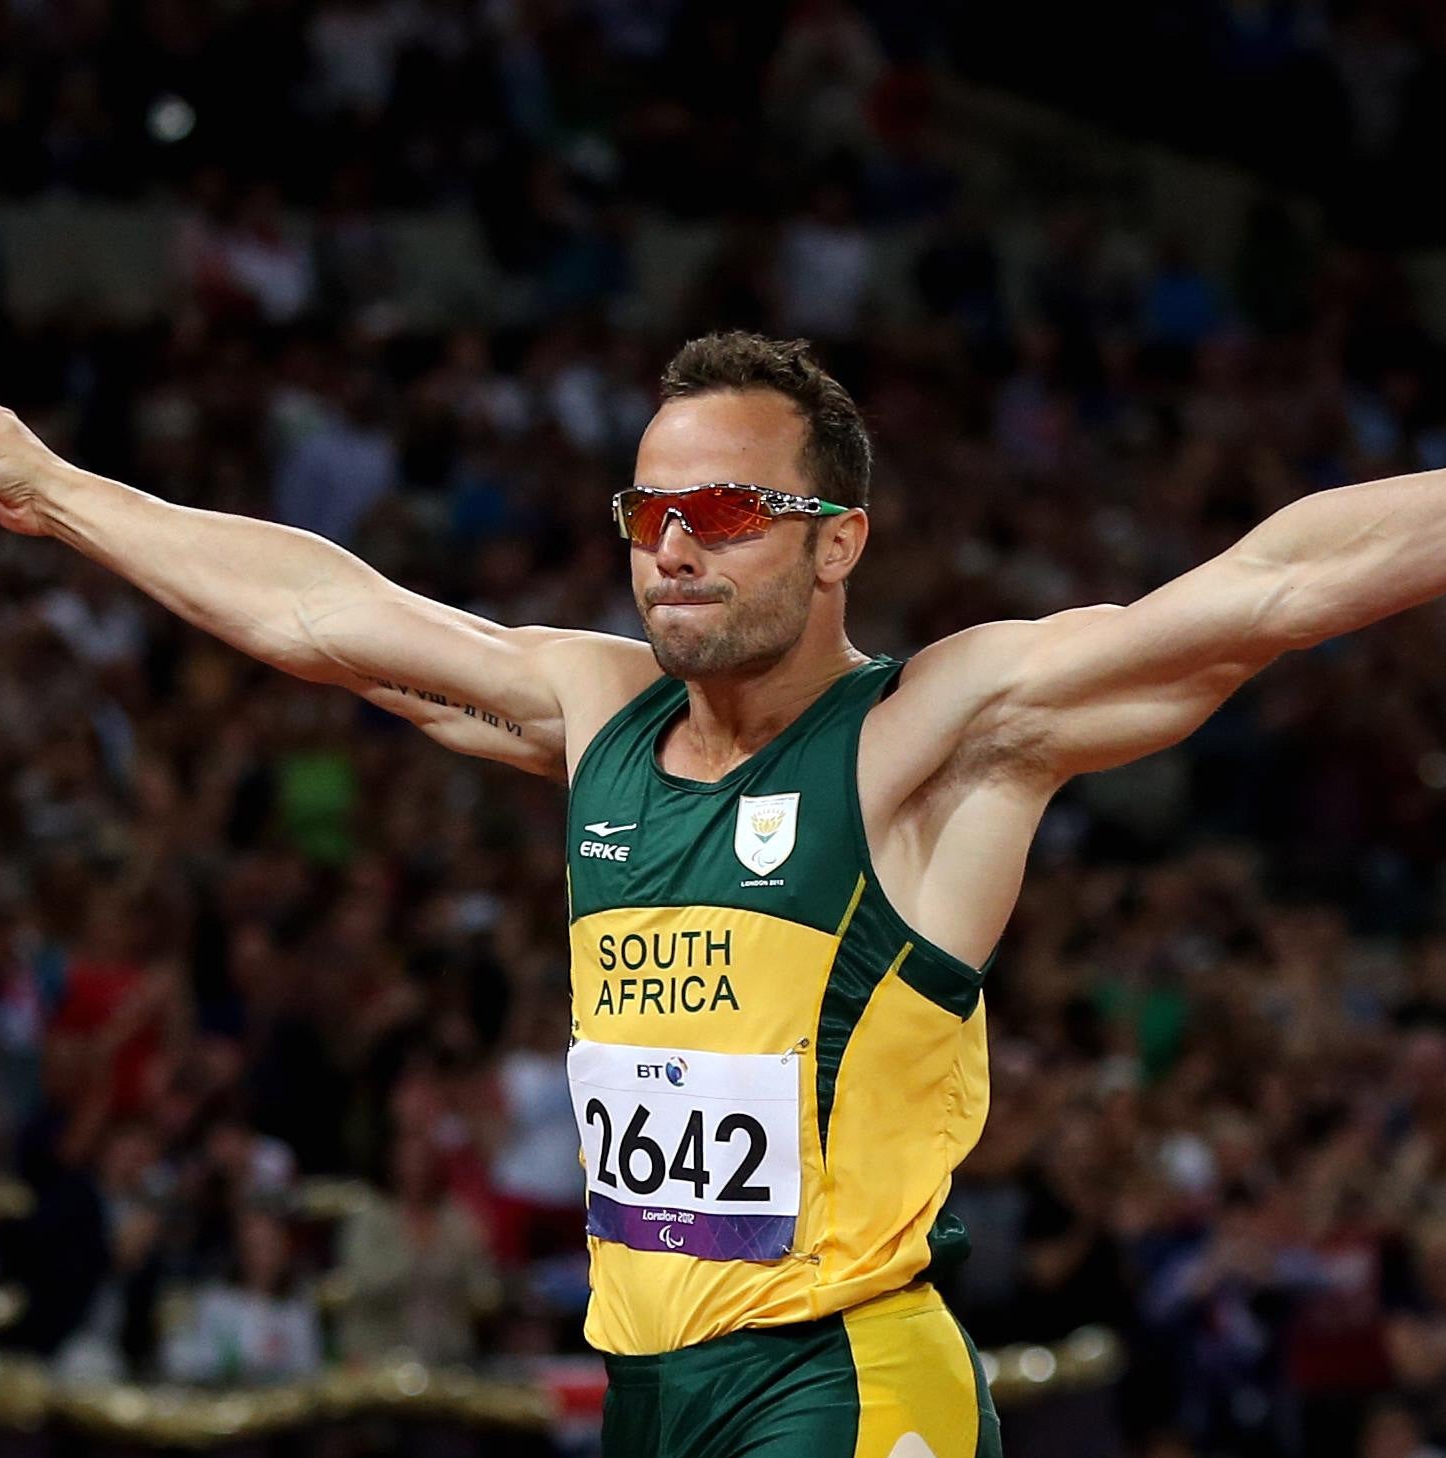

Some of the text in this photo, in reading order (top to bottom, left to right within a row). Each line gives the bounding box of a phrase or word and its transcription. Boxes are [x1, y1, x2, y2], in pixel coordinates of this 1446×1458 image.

[505, 719, 523, 737] VI
[580, 841, 630, 862] ERKE
[599, 930, 732, 971] SOUTH
[594, 975, 740, 1016] AFRICA
[637, 1064, 663, 1079] BT
[586, 1098, 771, 1201] 2642
[642, 1209, 695, 1225] London 2012
